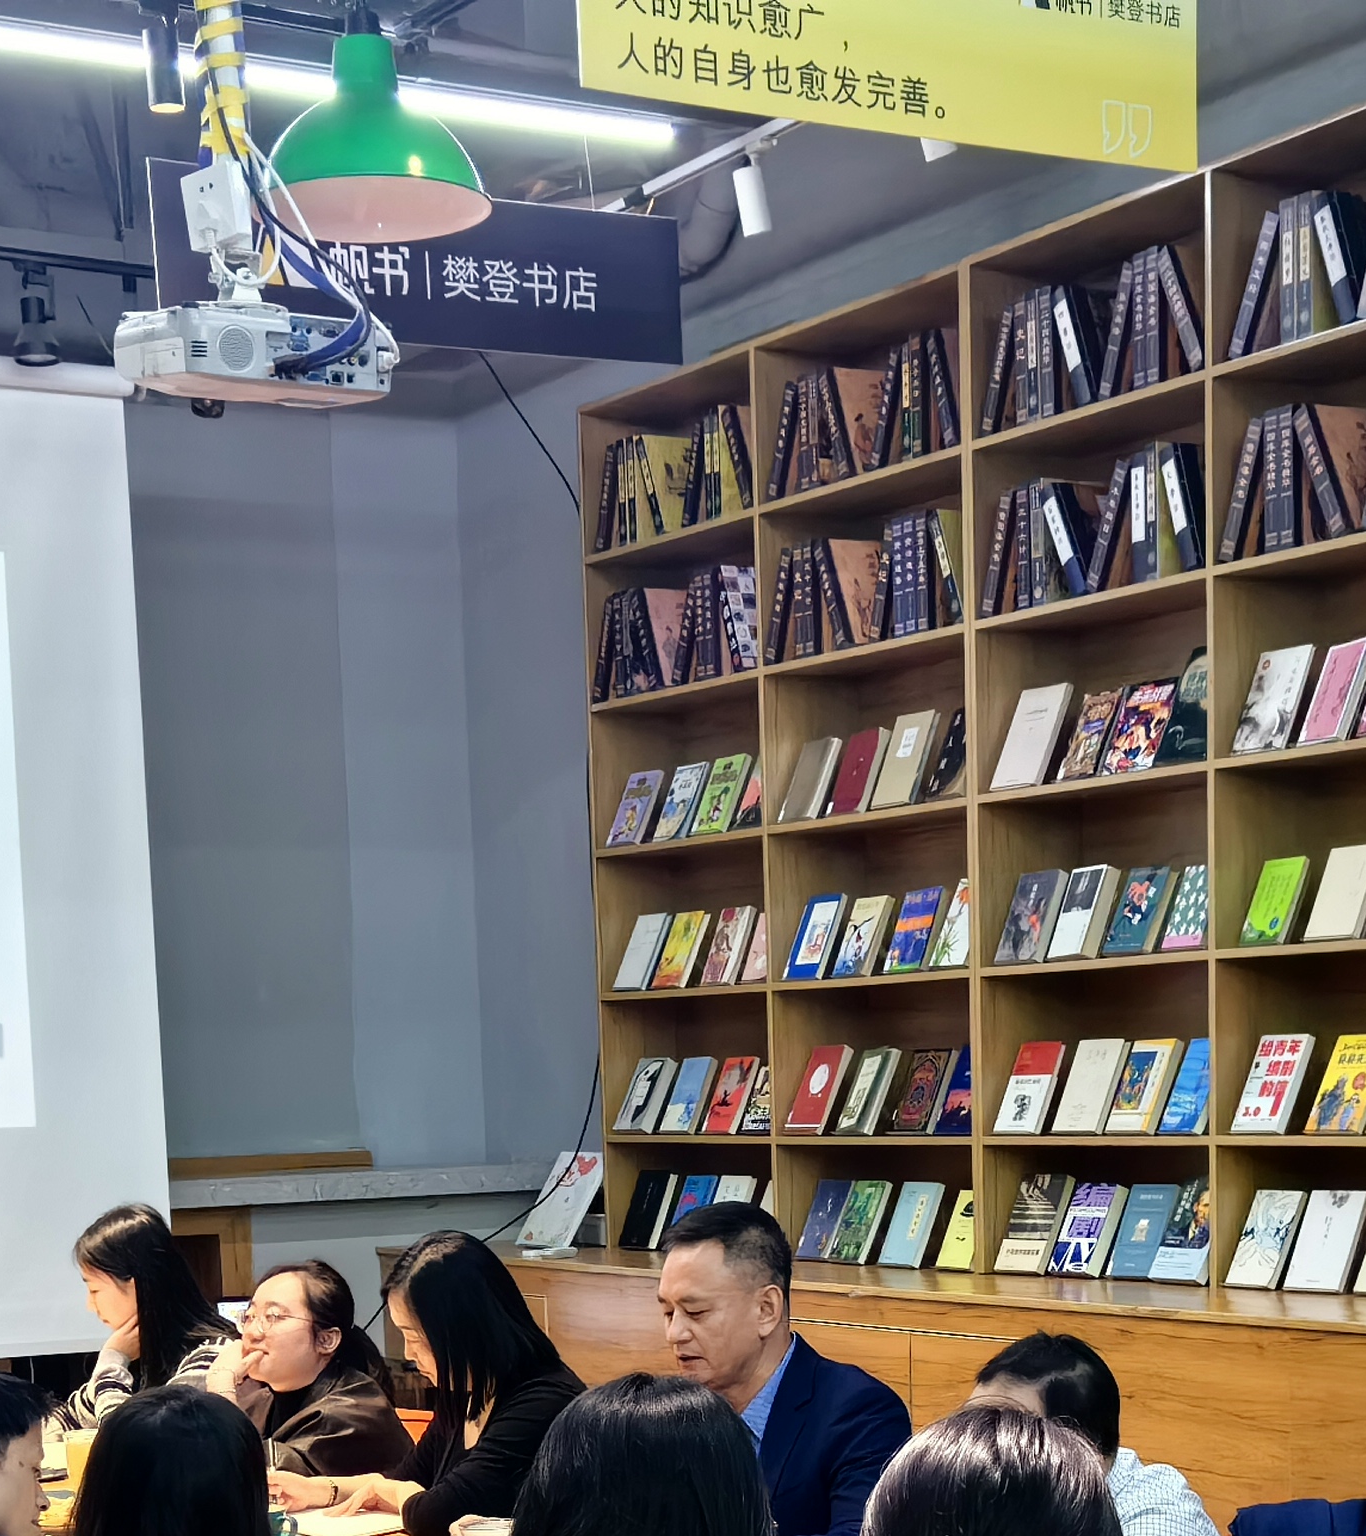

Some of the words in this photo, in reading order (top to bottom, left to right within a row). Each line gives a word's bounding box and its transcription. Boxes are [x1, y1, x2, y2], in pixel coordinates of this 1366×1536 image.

[1107, 0, 1181, 28] 樊登书店
[618, 32, 946, 119] 人的自身也愈发完善。
[329, 242, 409, 296] 帆书
[442, 253, 598, 312] 樊登书店
[1258, 1039, 1303, 1057] 给青年
